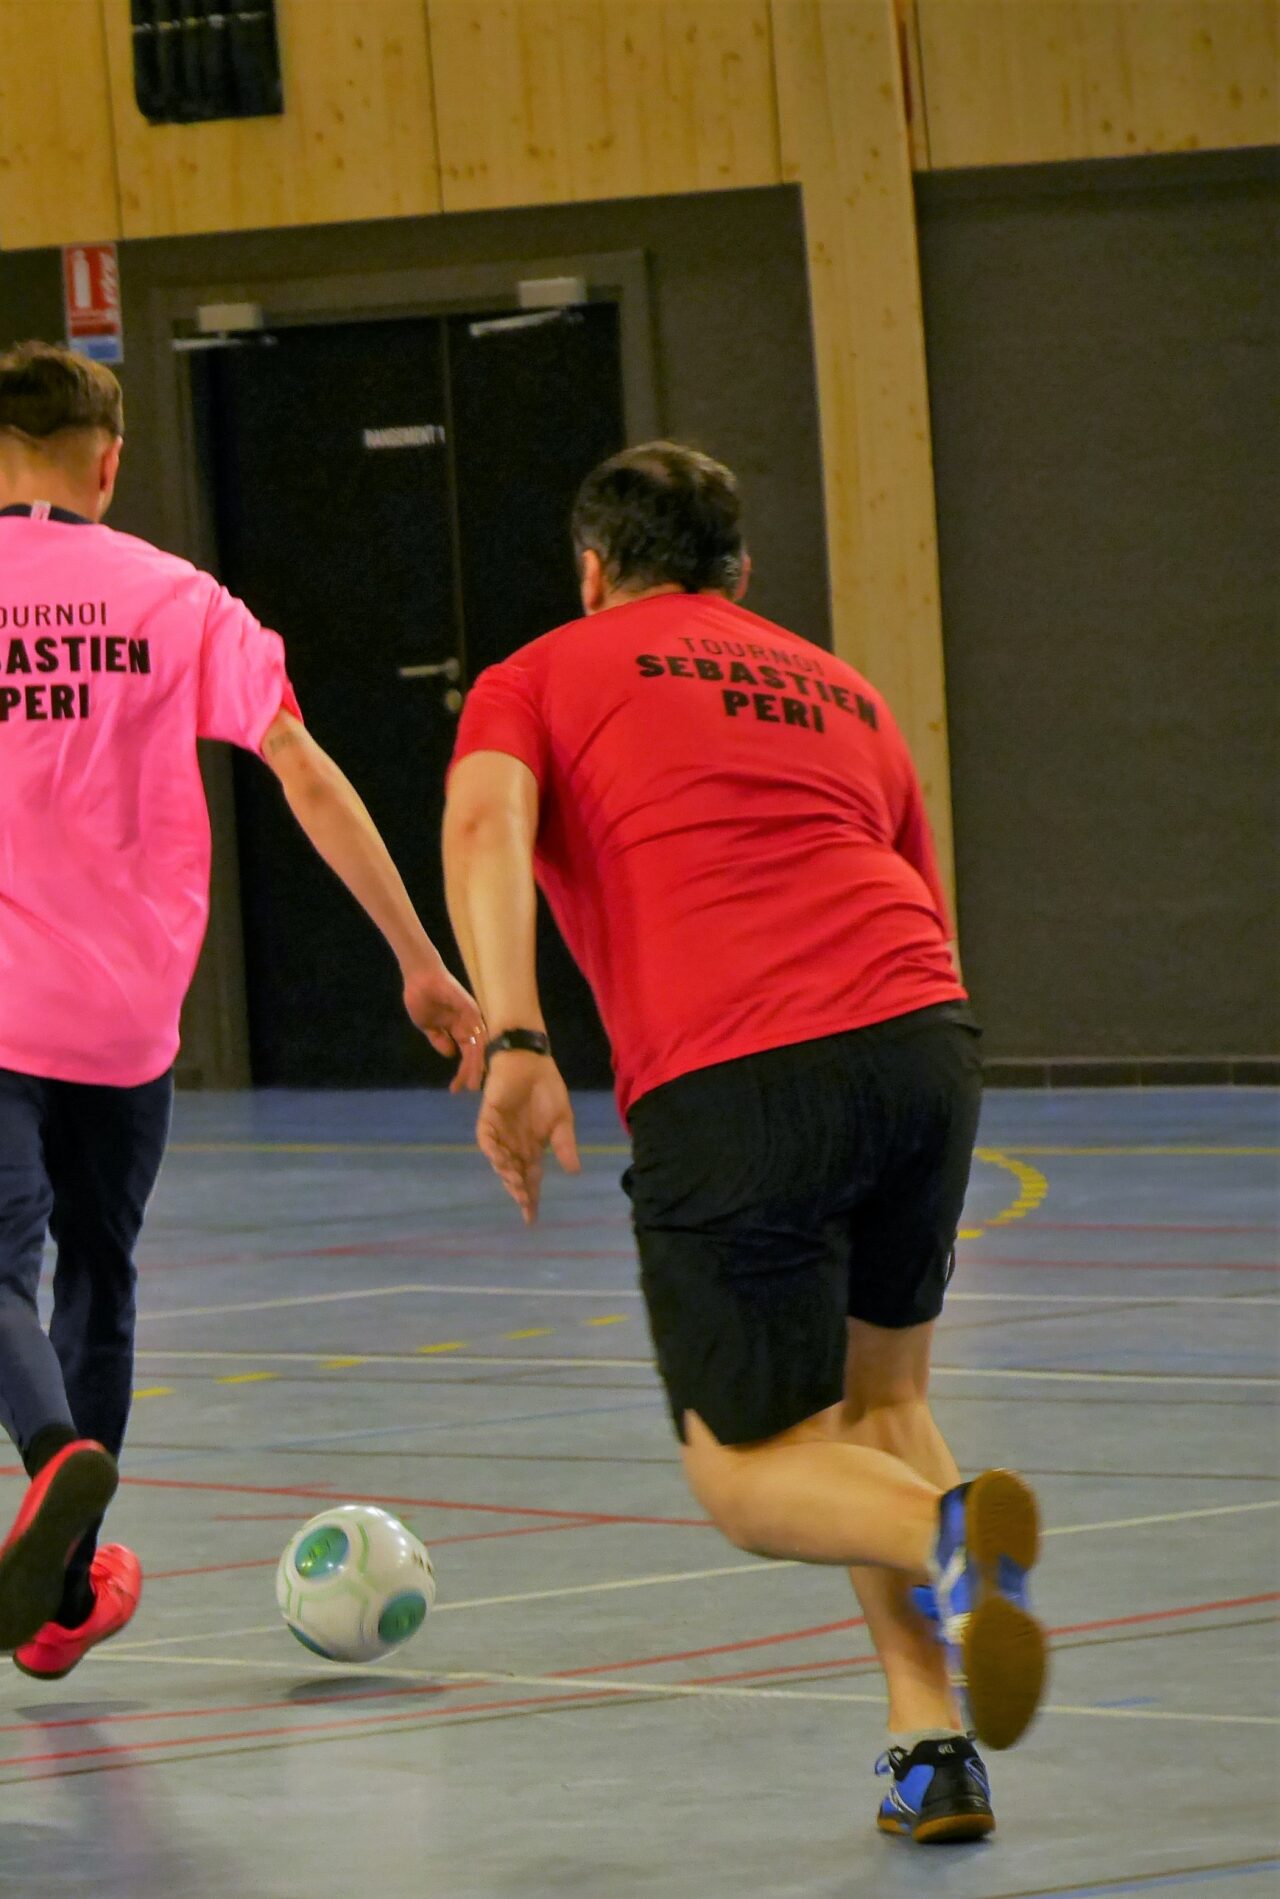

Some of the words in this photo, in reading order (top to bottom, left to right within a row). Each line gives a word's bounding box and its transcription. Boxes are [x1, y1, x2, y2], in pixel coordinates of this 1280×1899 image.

[679, 637, 824, 675] TOURNOI
[636, 654, 879, 732] SEBASTIEN
[722, 689, 825, 733] PERI
